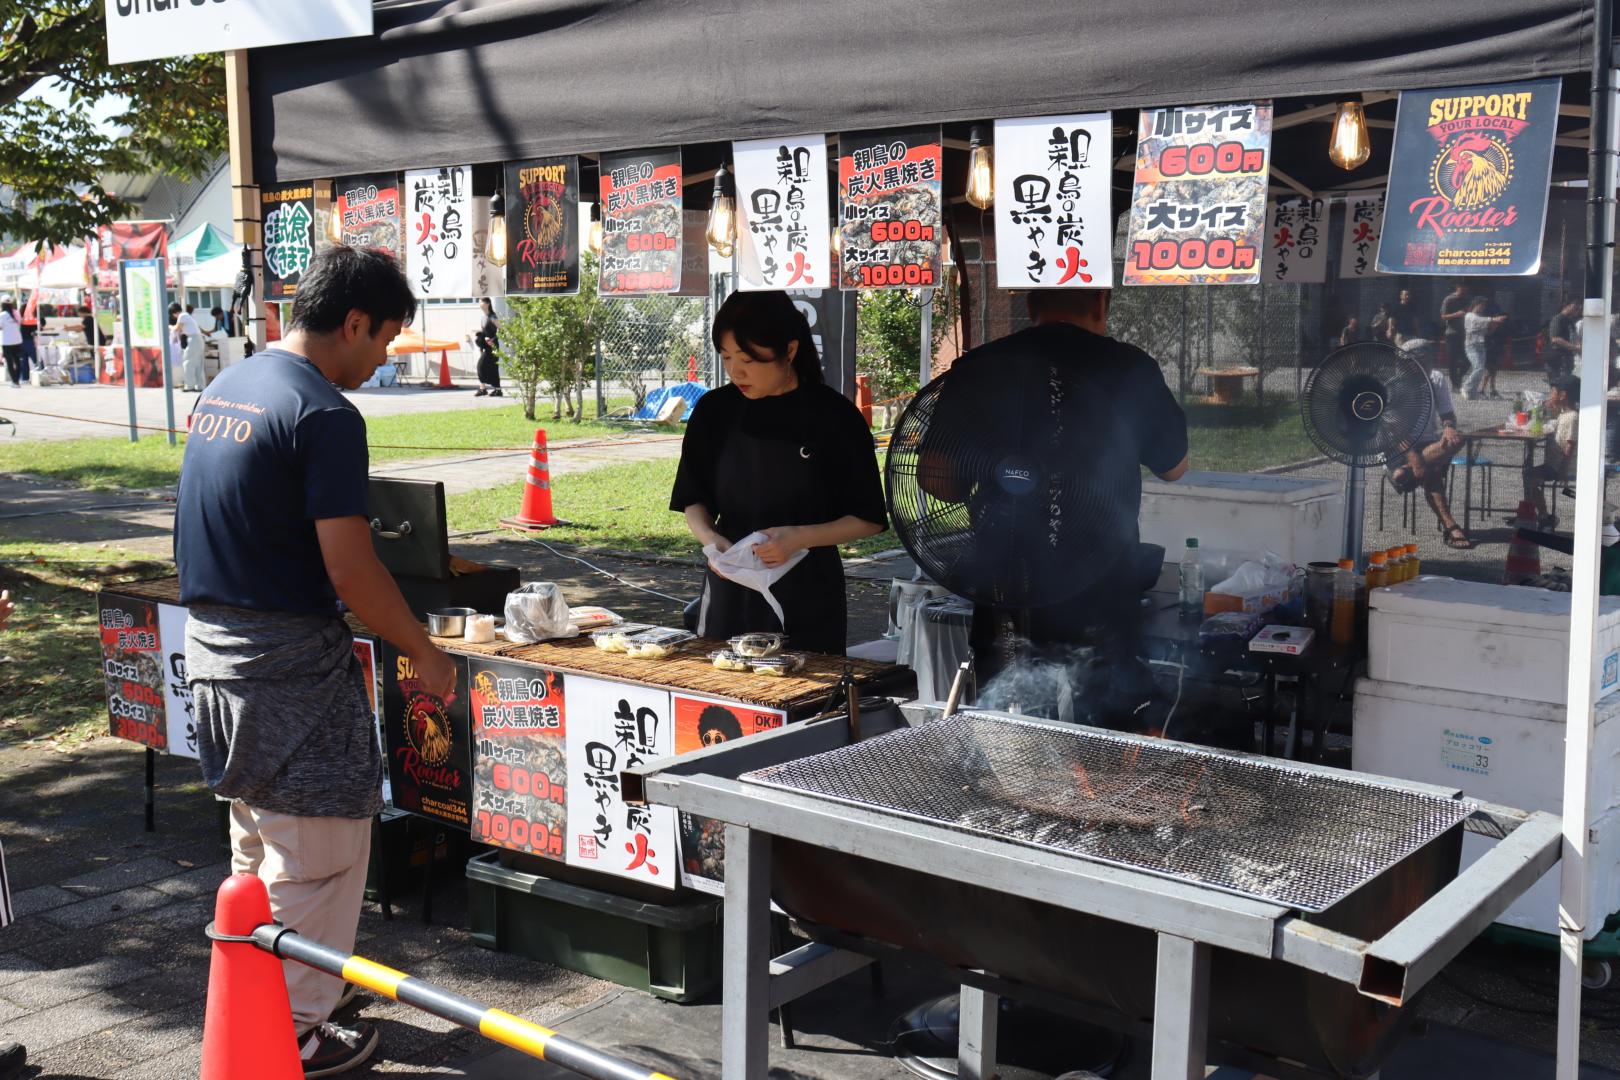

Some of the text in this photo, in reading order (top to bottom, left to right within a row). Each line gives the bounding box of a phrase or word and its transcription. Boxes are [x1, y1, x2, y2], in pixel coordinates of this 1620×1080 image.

[1153, 109, 1254, 138] 小サイズ
[1428, 92, 1532, 127] SUPPORT
[1440, 118, 1514, 133] YOUR LOCAL
[853, 141, 907, 172] 親鳥の
[1159, 141, 1265, 177] 600円
[520, 165, 566, 190] SUPPORT
[611, 162, 654, 189] 親鳥の
[848, 158, 935, 198] 炭火黒焼き
[345, 185, 379, 208] 親鳥の
[607, 177, 677, 212] 炭火黒焼き
[265, 203, 312, 246] ご試食
[343, 199, 396, 228] 炭火黒焼き
[437, 166, 464, 260] 親鳥の
[605, 218, 642, 233] 小サイズ
[844, 204, 891, 220] 小サイズ
[1146, 201, 1249, 231] 大サイズ
[1408, 196, 1519, 238] Rooster
[414, 178, 438, 293] 炭火やき
[627, 232, 677, 251] 600円
[750, 188, 782, 285] 黒やき
[871, 219, 934, 242] 600円
[1010, 174, 1051, 283] 黒やき
[265, 241, 312, 278] できます
[844, 246, 891, 262] 大サイズ
[1132, 239, 1256, 270] 1000円
[1438, 248, 1511, 258] charcoal344
[860, 264, 933, 286] 1000円
[189, 412, 252, 443] TOJYO
[1005, 469, 1030, 478] NAFCO
[101, 608, 134, 629] 親鳥の
[118, 631, 156, 649] 炭火焼き
[122, 681, 162, 706] 600円
[498, 678, 547, 701] 親鳥の
[482, 705, 560, 729] 炭火黒焼き
[480, 739, 525, 764] 小サイズ
[1475, 754, 1489, 768] 33
[492, 763, 565, 805] 600円
[584, 741, 620, 849] 黒やき
[614, 699, 659, 875] 親炭火
[480, 790, 527, 816] 大サイズ
[477, 809, 564, 854] 1000円
